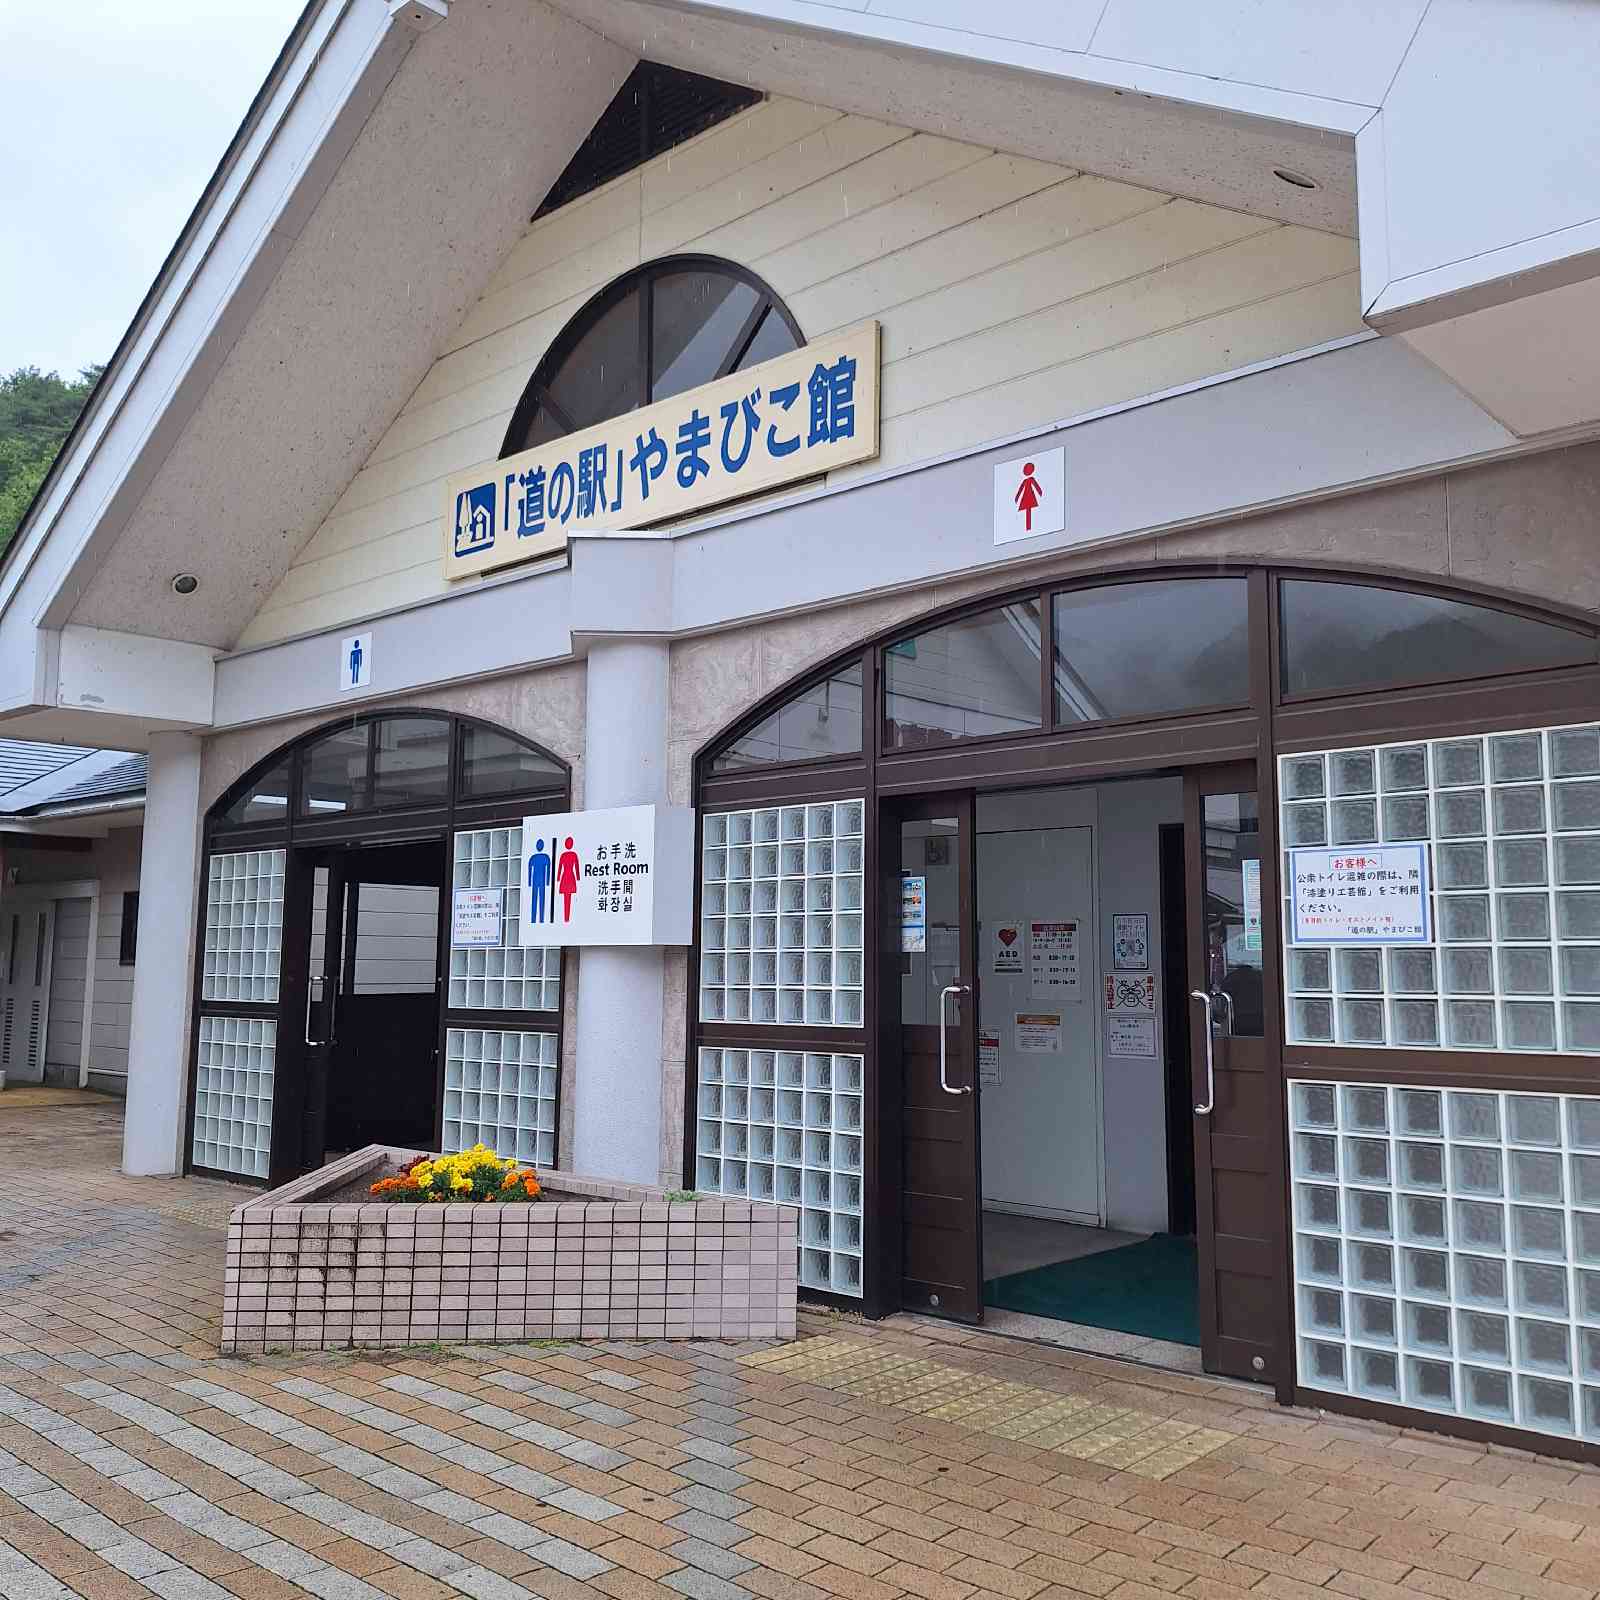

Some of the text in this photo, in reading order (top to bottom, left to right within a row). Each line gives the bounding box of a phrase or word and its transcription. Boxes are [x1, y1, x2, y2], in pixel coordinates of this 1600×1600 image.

[504, 355, 857, 539] 「道の駅」やまびこ館
[596, 842, 637, 860] お手洗
[584, 862, 649, 877] Rest Room
[1334, 857, 1377, 869] お客様へ
[598, 880, 633, 895] 洗手間
[598, 896, 633, 912] 화장실
[1299, 903, 1343, 913] ください。
[998, 950, 1018, 958] AED
